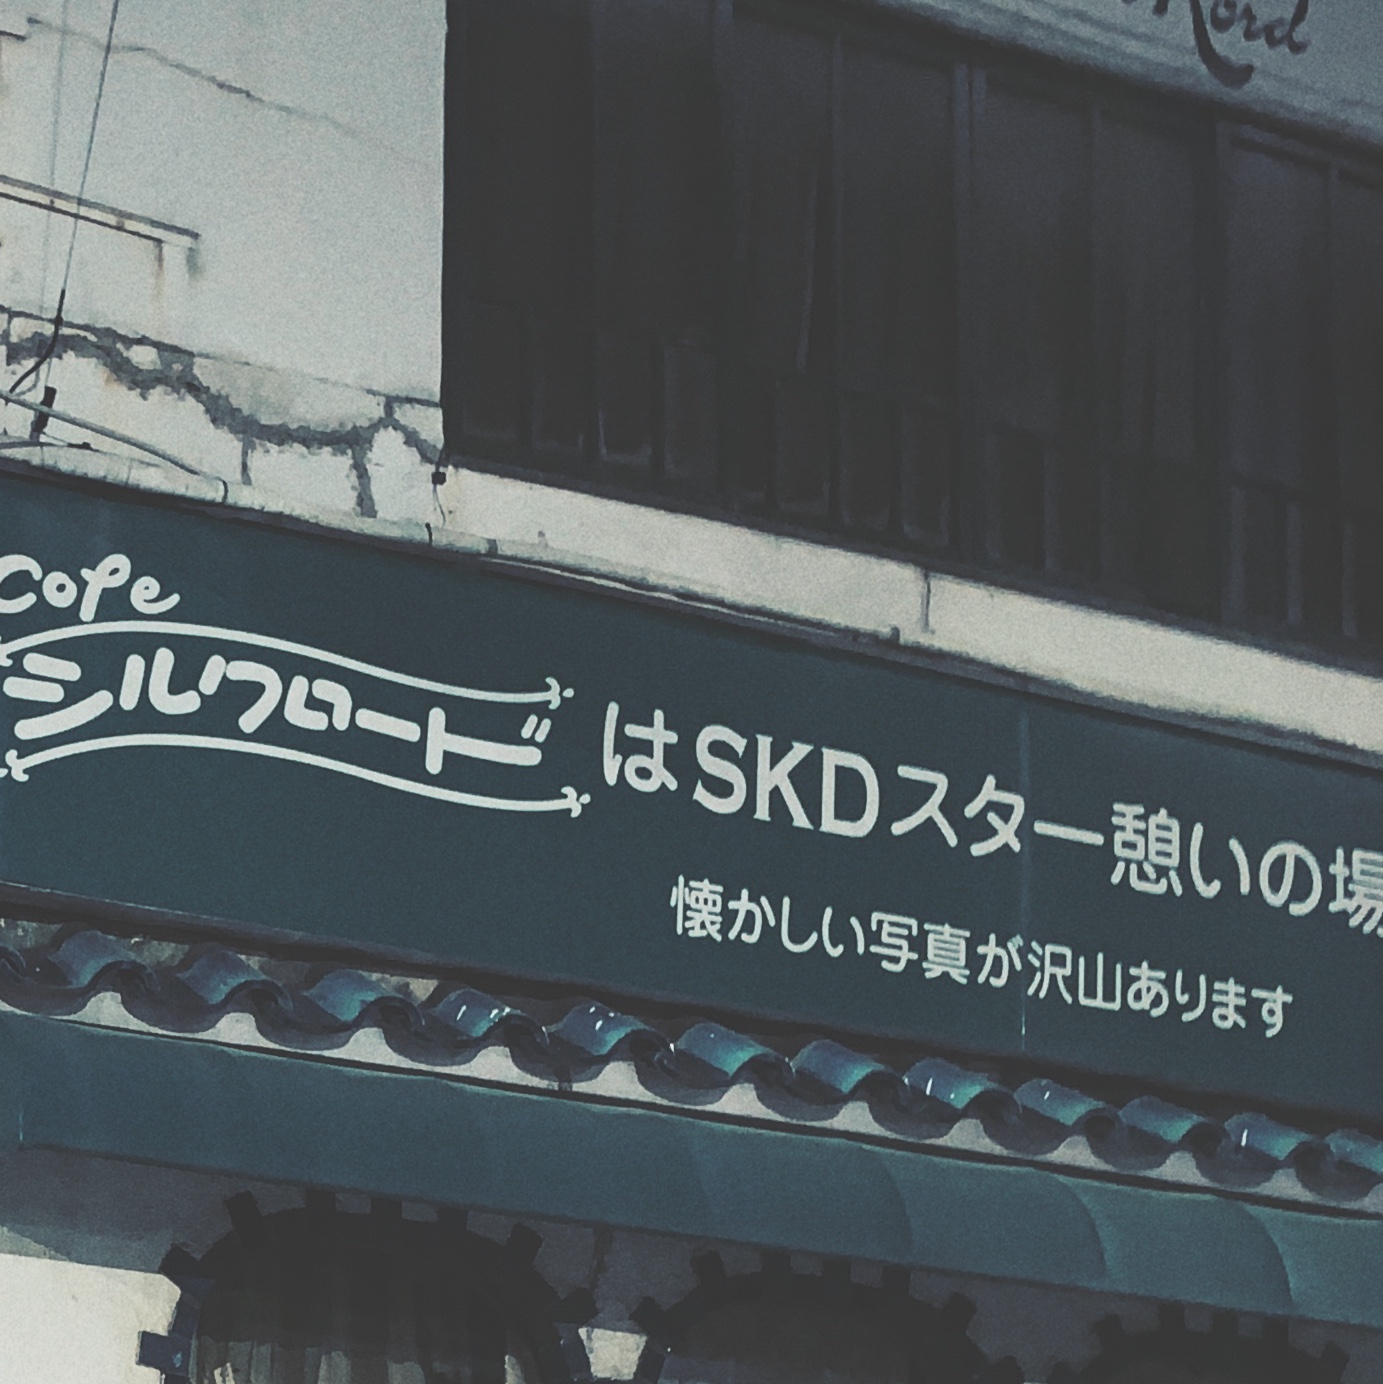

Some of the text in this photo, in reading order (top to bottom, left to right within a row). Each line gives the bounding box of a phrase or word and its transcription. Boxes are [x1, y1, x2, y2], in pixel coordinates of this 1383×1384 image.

[3, 647, 551, 775] シルクロード
[669, 874, 1293, 1038] 懐かしい写真が沢山あります
